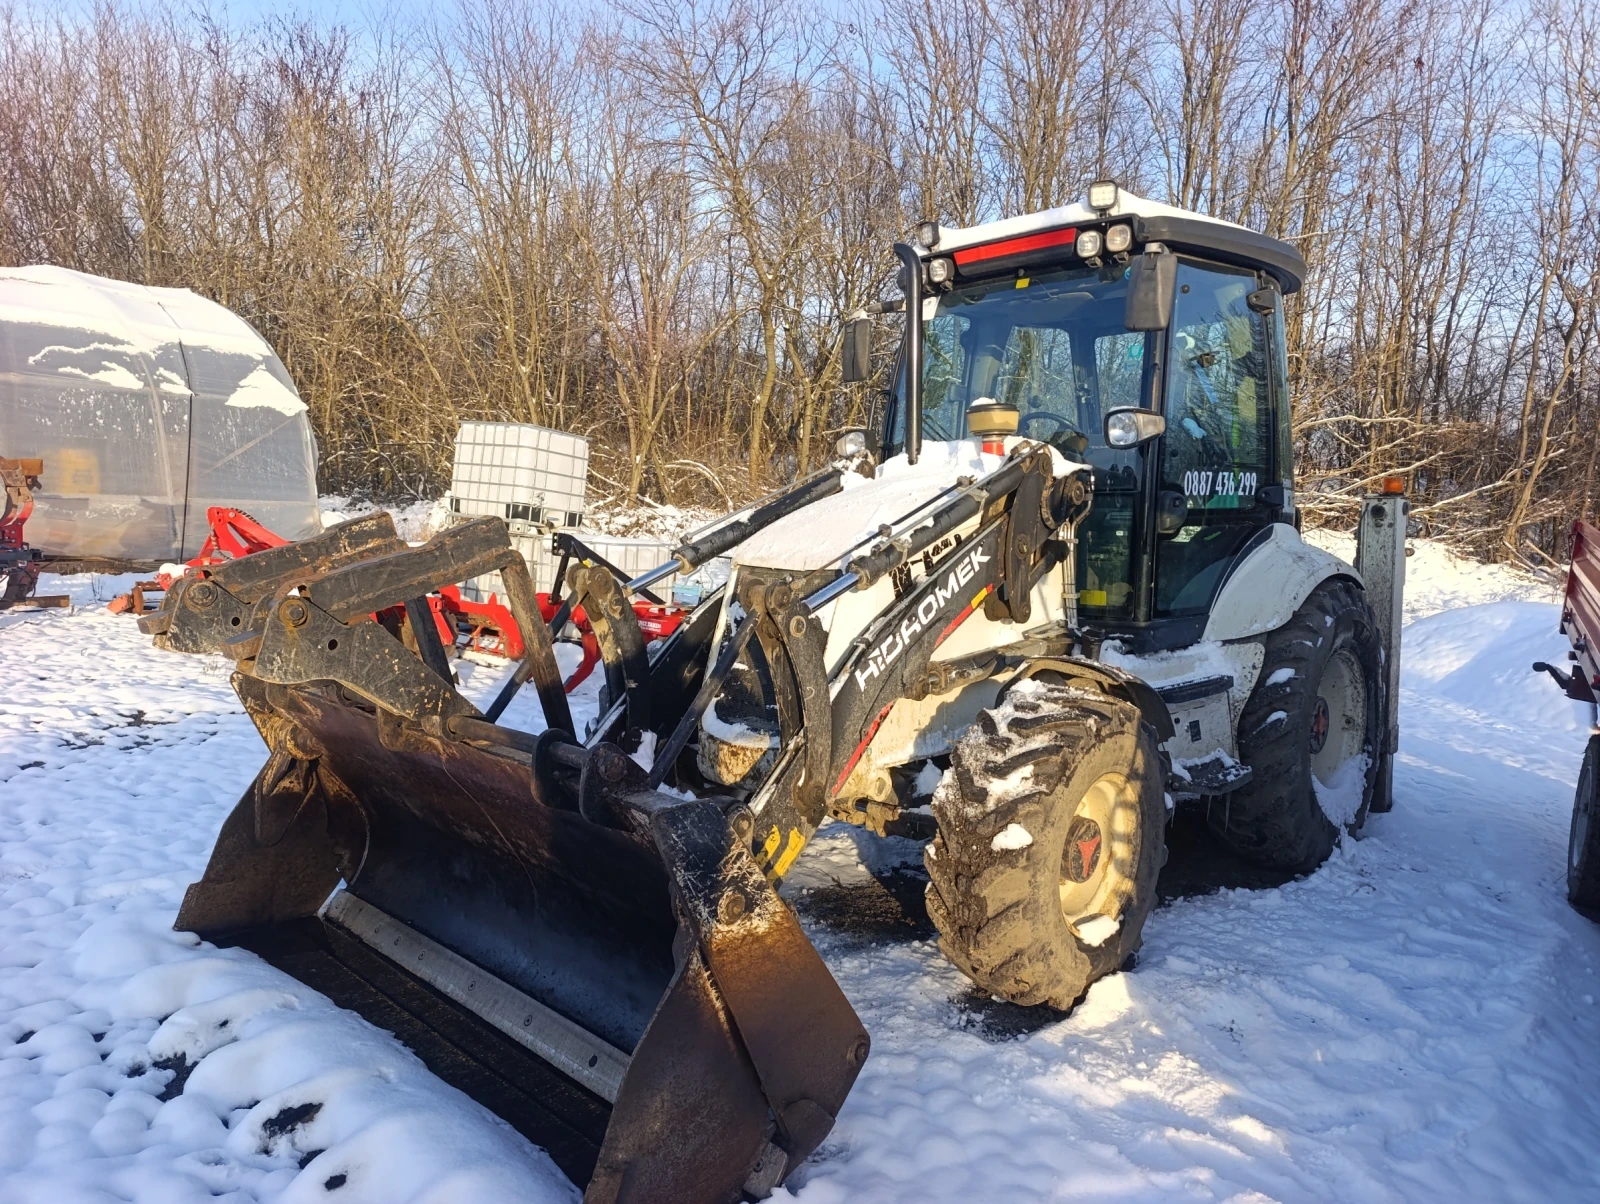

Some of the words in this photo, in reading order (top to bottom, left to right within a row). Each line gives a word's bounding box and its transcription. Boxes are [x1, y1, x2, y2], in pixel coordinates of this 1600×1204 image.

[1184, 471, 1213, 496] 0887
[1215, 471, 1235, 496] 436
[1238, 472, 1257, 496] 299
